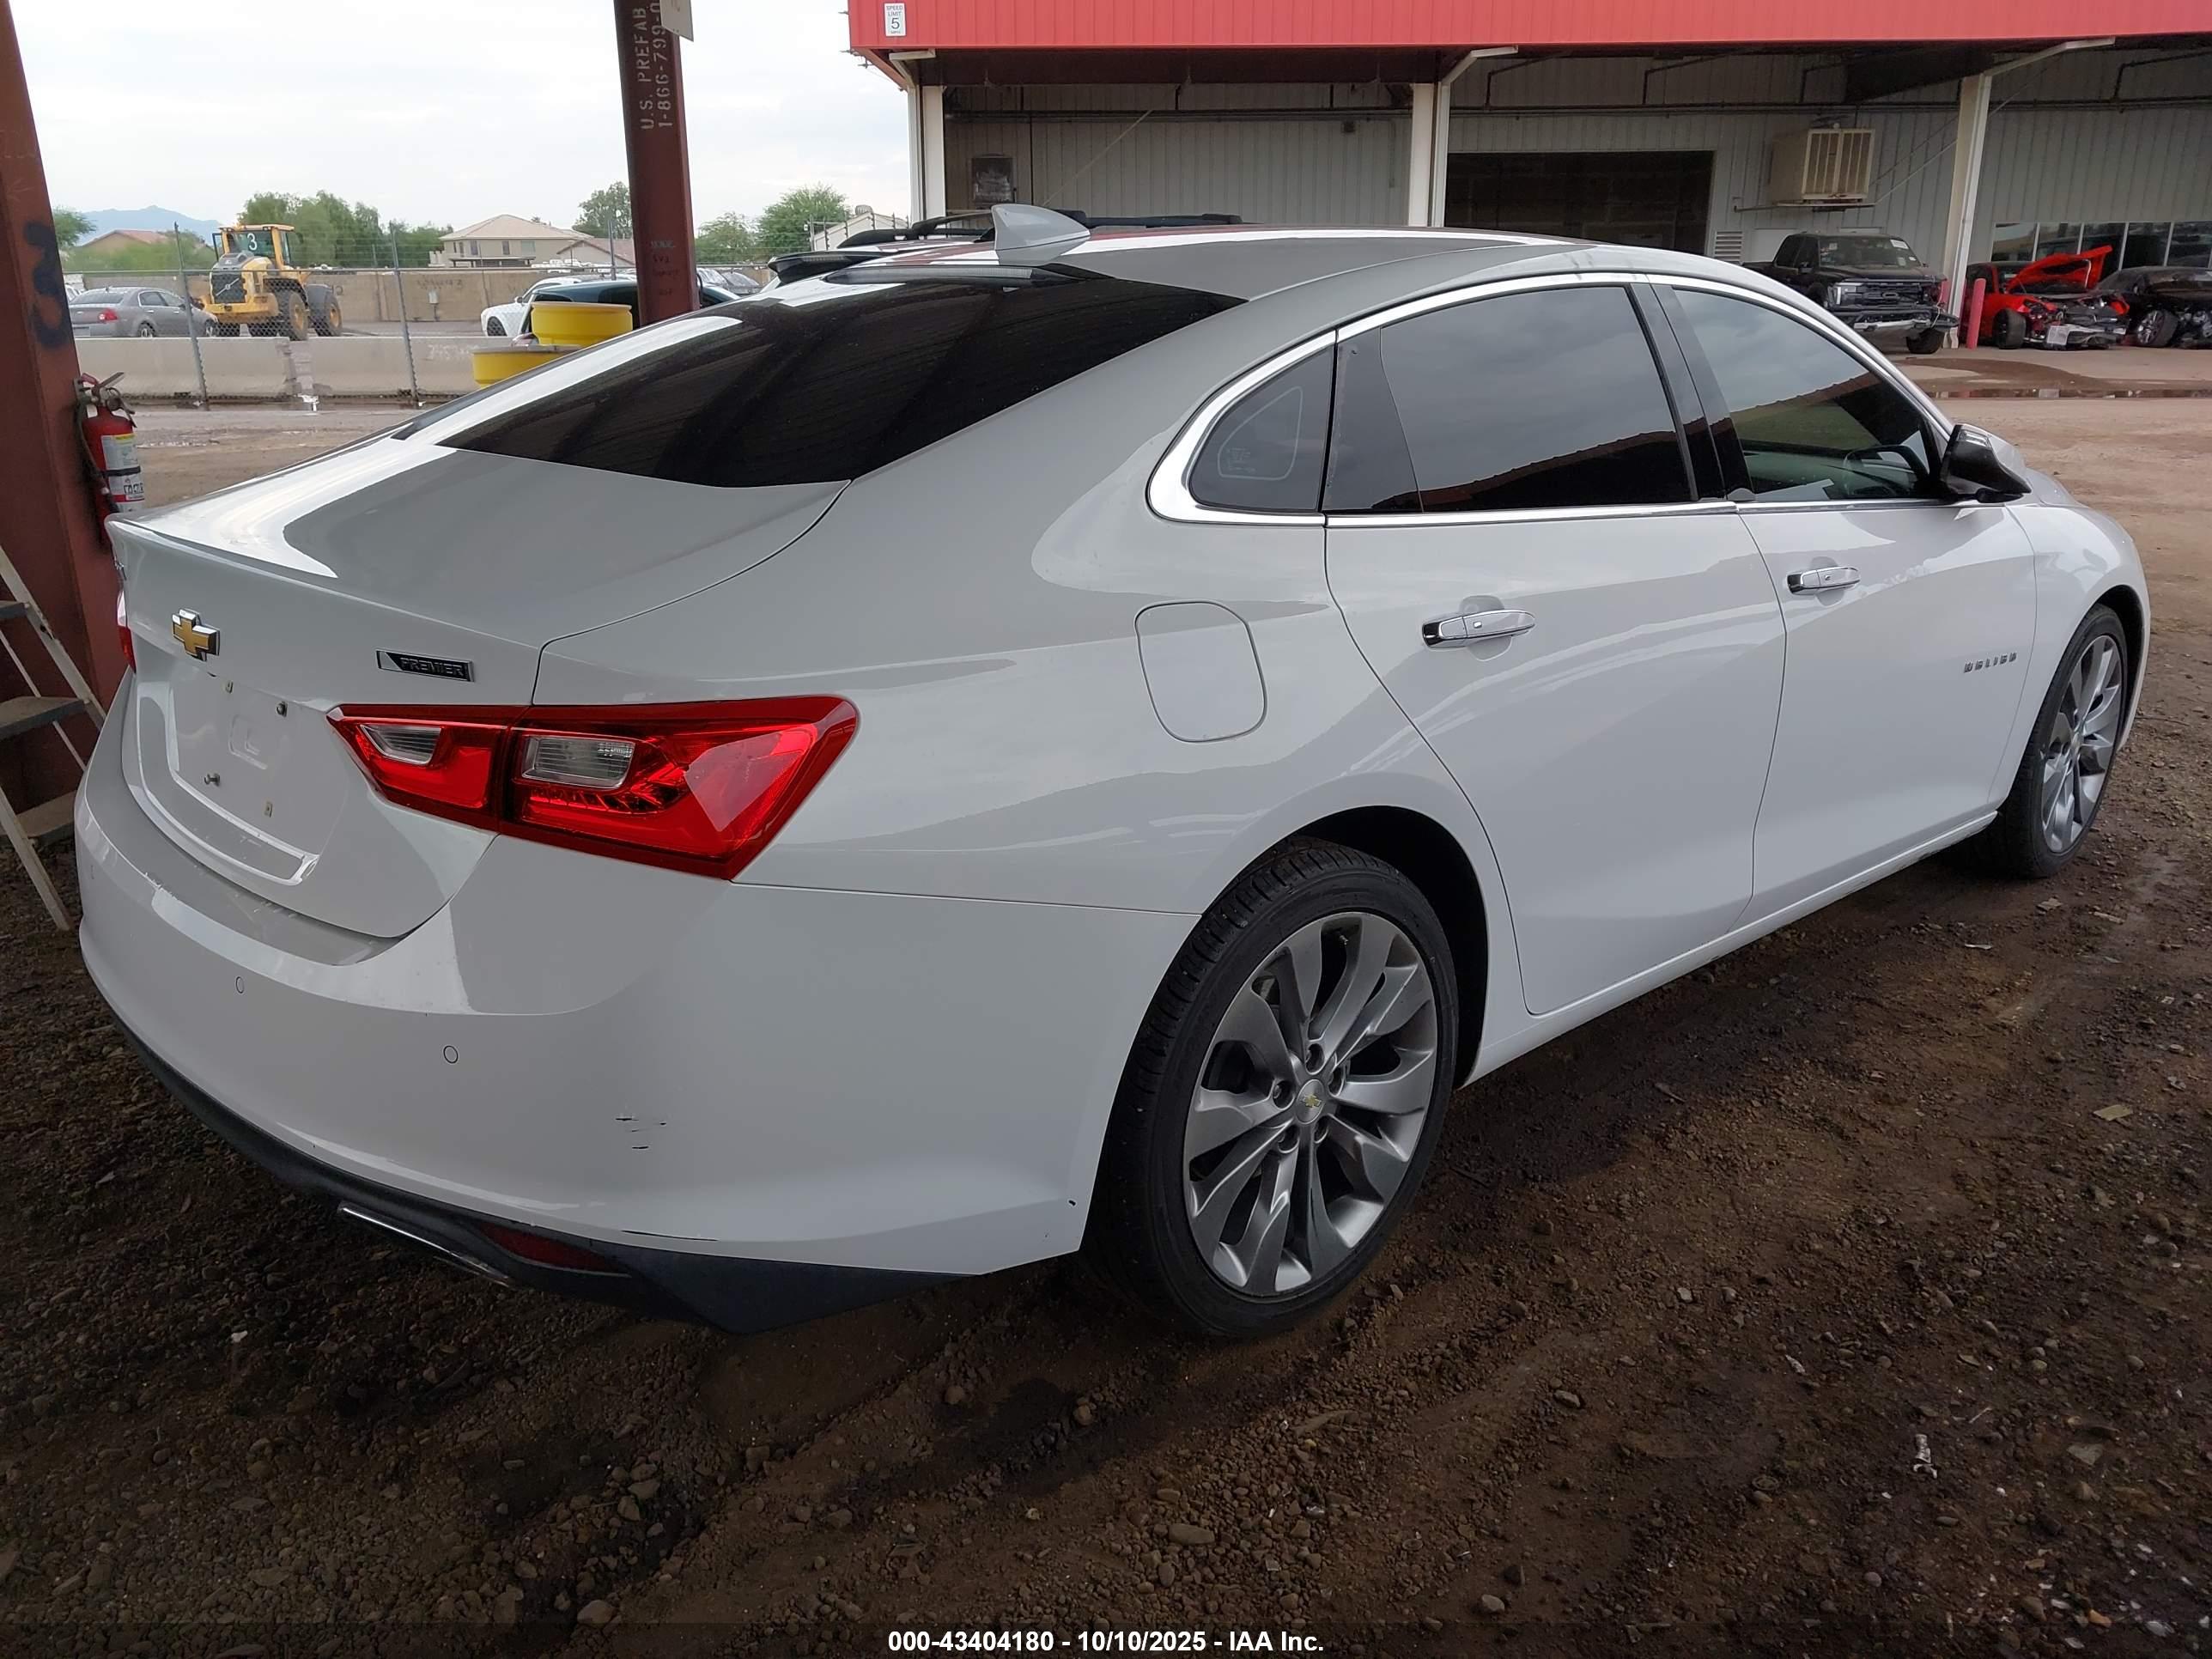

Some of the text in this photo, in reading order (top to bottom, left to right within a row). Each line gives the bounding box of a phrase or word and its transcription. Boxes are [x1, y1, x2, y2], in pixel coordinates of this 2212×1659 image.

[891, 17, 900, 29] 5
[632, 8, 654, 130] U.S. PREFAB
[246, 233, 258, 251] 3
[399, 657, 465, 677] PREMIER
